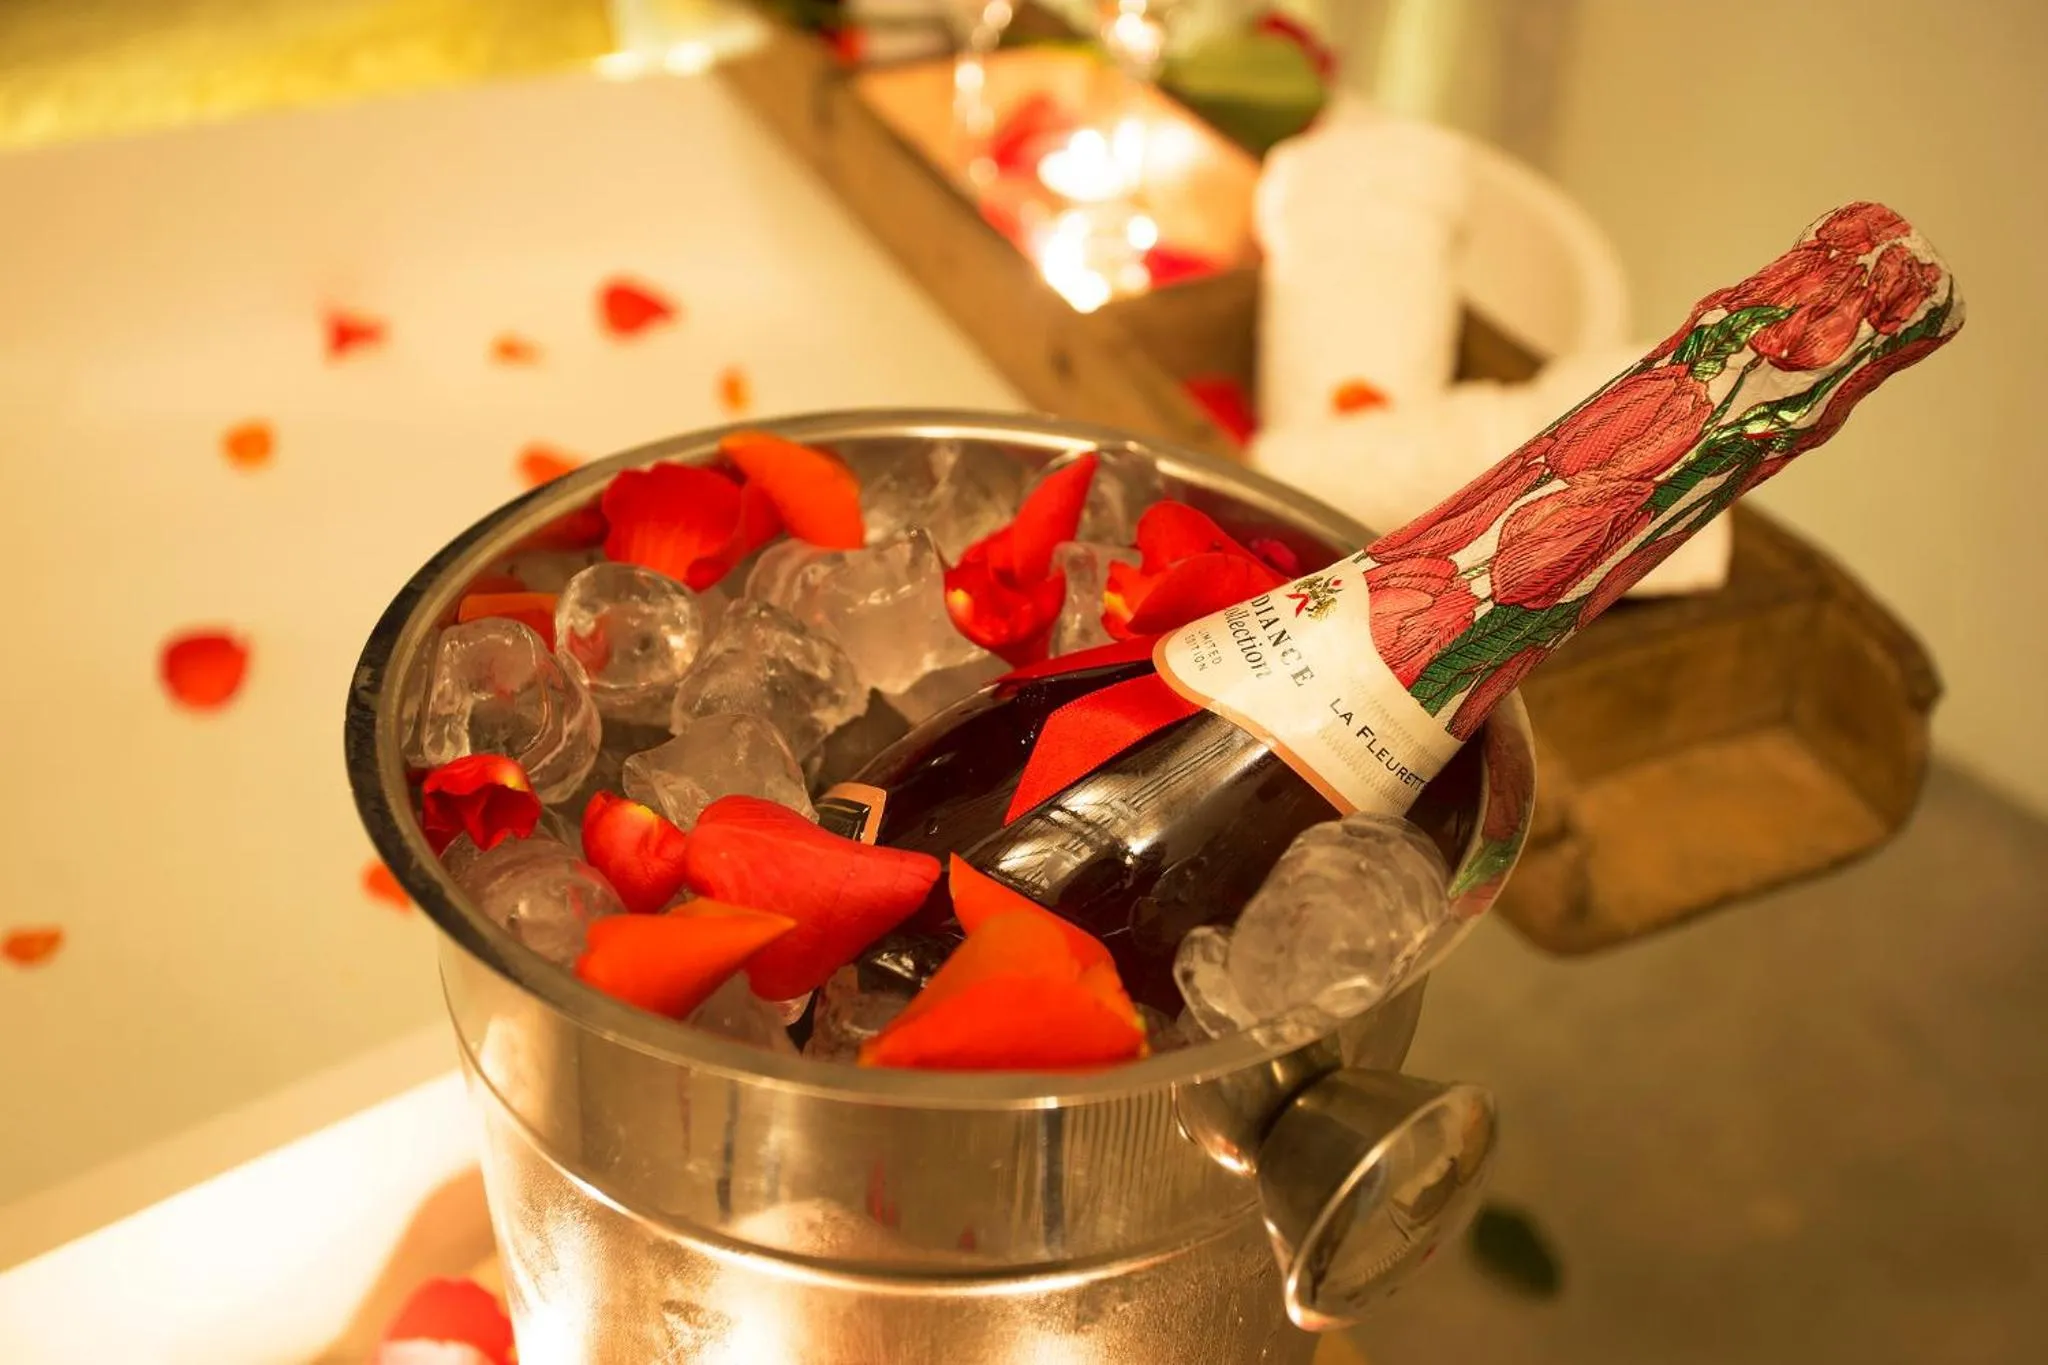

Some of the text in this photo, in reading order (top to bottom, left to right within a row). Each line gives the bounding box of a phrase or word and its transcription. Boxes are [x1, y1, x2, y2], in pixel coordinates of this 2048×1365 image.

[1224, 606, 1273, 680] ollection
[1251, 594, 1315, 687] DIANCE
[1330, 698, 1427, 792] LA FLEURETT
